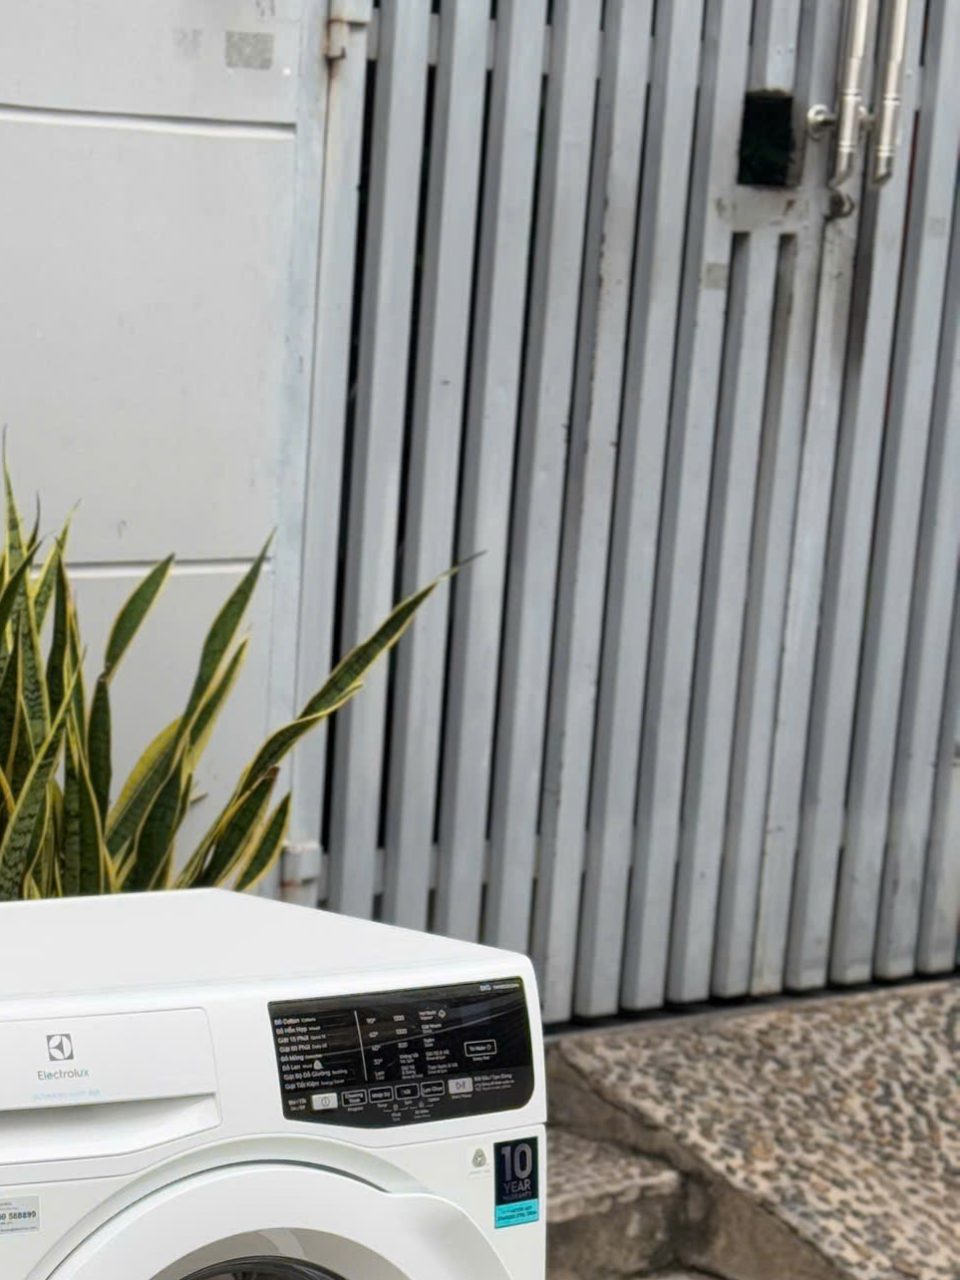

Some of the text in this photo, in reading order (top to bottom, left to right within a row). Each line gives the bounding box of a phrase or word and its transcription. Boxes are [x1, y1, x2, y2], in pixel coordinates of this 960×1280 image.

[37, 1068, 89, 1080] Electrolux
[501, 1143, 533, 1181] 10
[504, 1179, 532, 1193] YEAR
